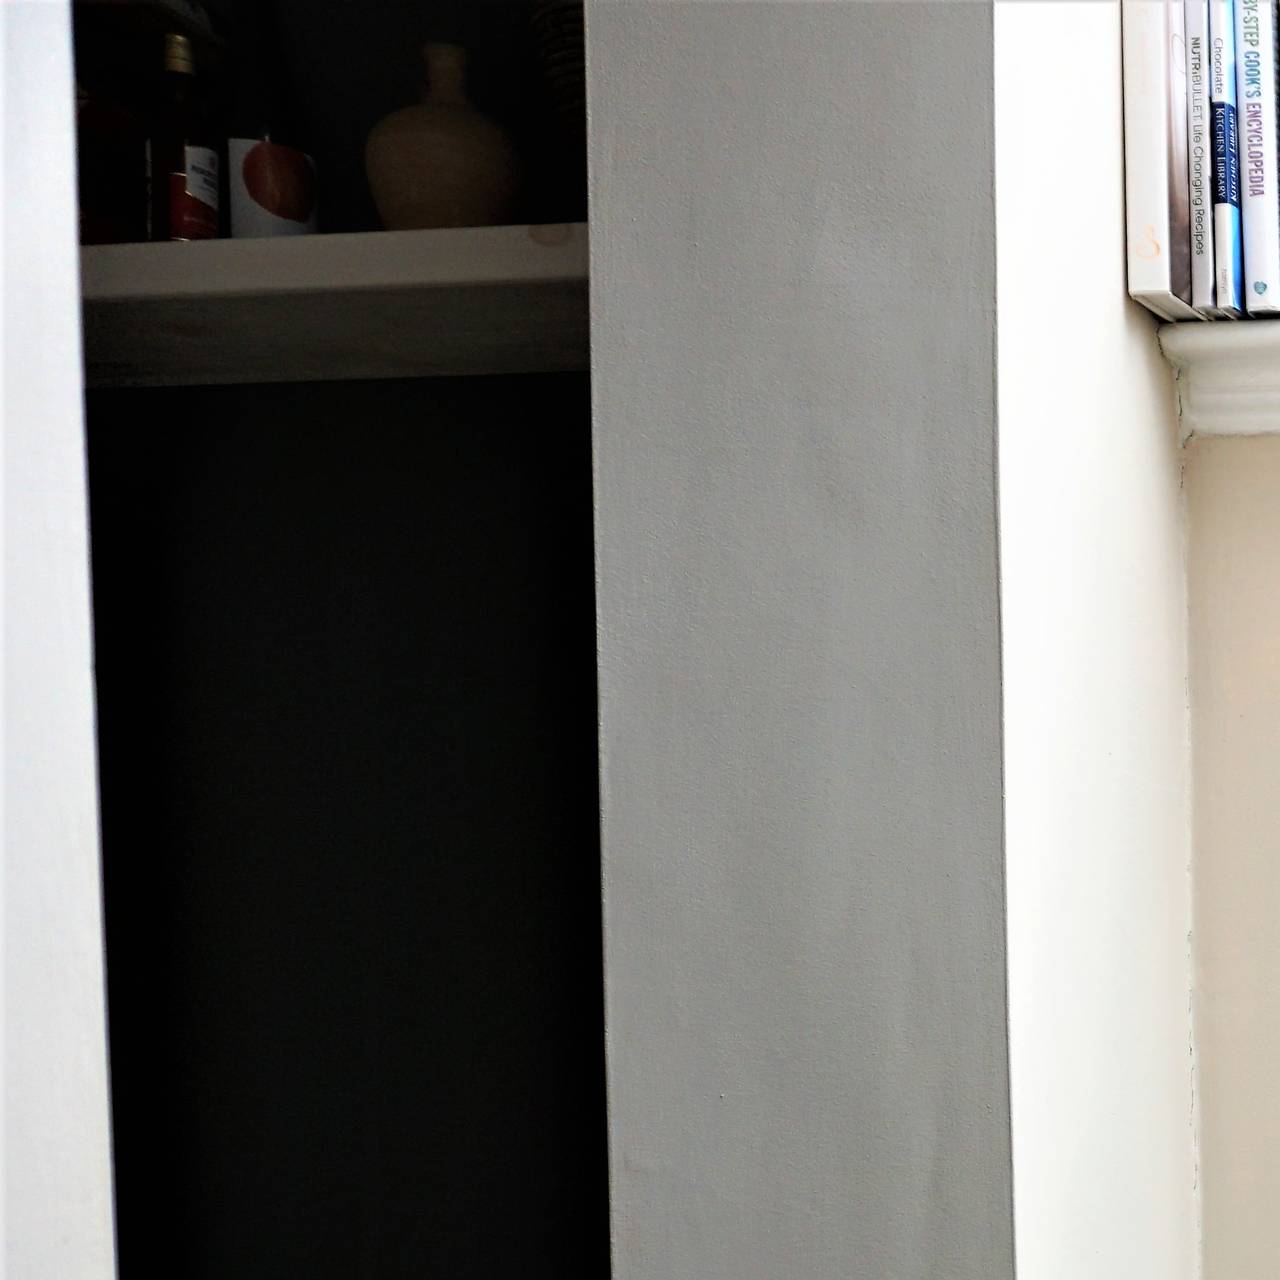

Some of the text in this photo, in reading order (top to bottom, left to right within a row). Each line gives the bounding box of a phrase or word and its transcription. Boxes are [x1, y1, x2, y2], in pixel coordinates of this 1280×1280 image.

[1213, 38, 1223, 94] Chocolate
[1216, 108, 1226, 197] KITCHEN LIBRARY
[1244, 51, 1265, 198] COOK'S ENCYCLOPEDIA
[1192, 124, 1205, 256] Life Changing Recipes
